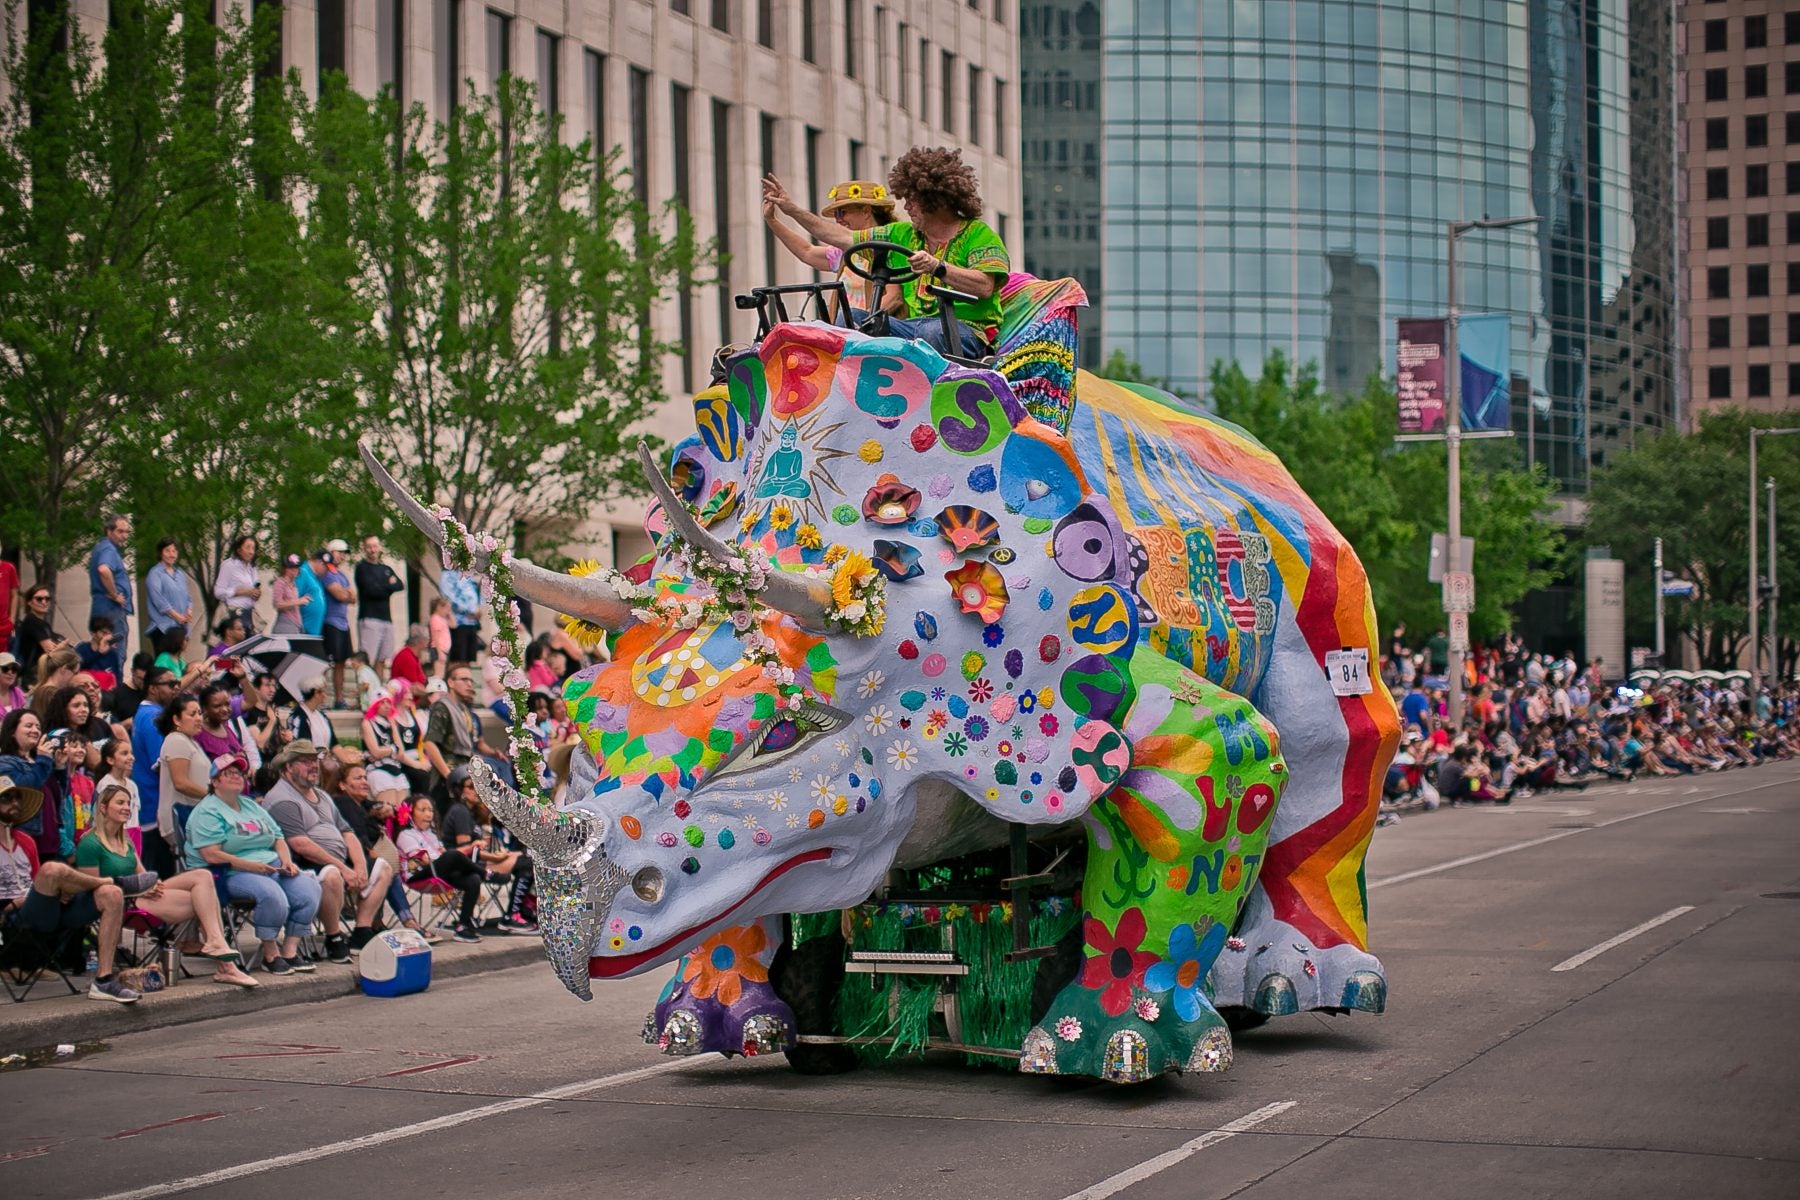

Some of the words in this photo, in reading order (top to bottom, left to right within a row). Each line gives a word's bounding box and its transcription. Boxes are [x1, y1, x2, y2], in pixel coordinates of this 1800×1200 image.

[696, 345, 995, 461] VIBES
[1342, 664, 1359, 682] 84
[1186, 849, 1262, 896] NOT
